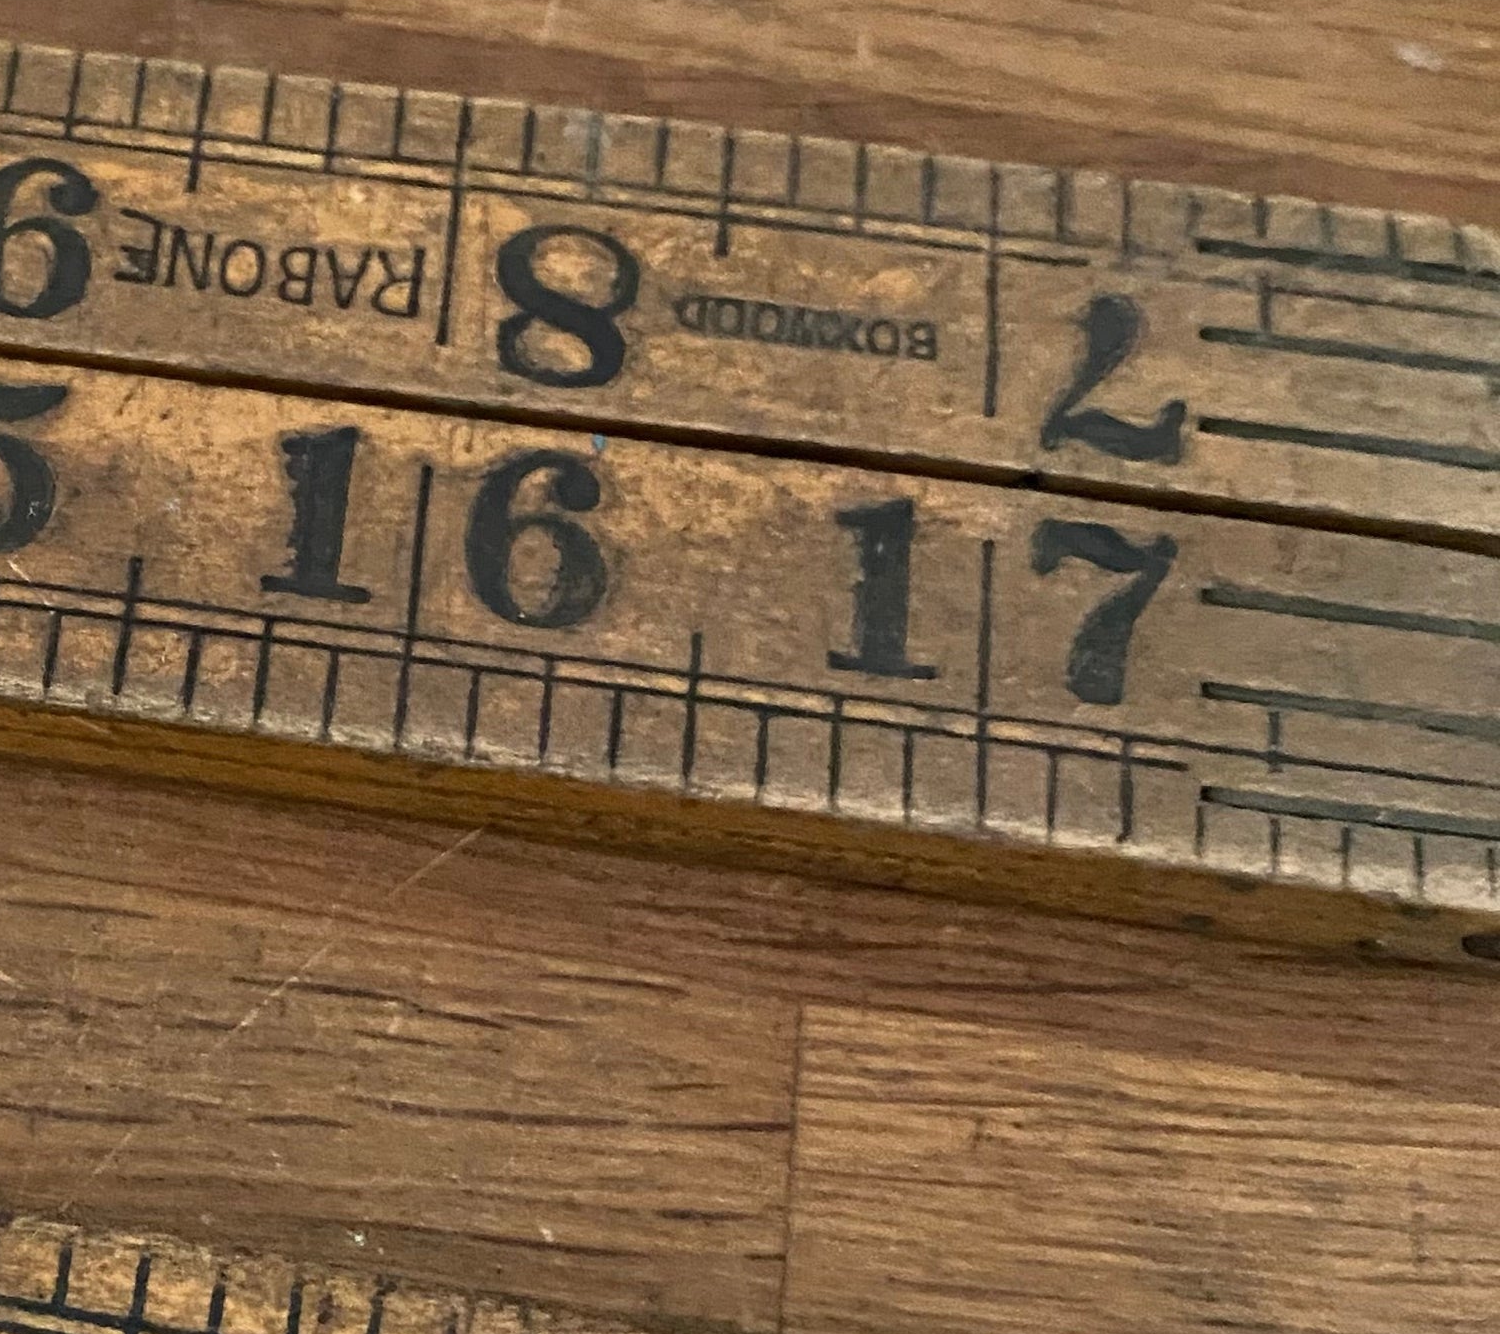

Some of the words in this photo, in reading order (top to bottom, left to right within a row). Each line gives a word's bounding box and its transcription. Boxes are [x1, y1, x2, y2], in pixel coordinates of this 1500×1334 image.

[115, 208, 427, 318] RABONE
[499, 224, 640, 388] 8
[674, 294, 938, 361] BOXWOOD
[1040, 293, 1186, 464] 7
